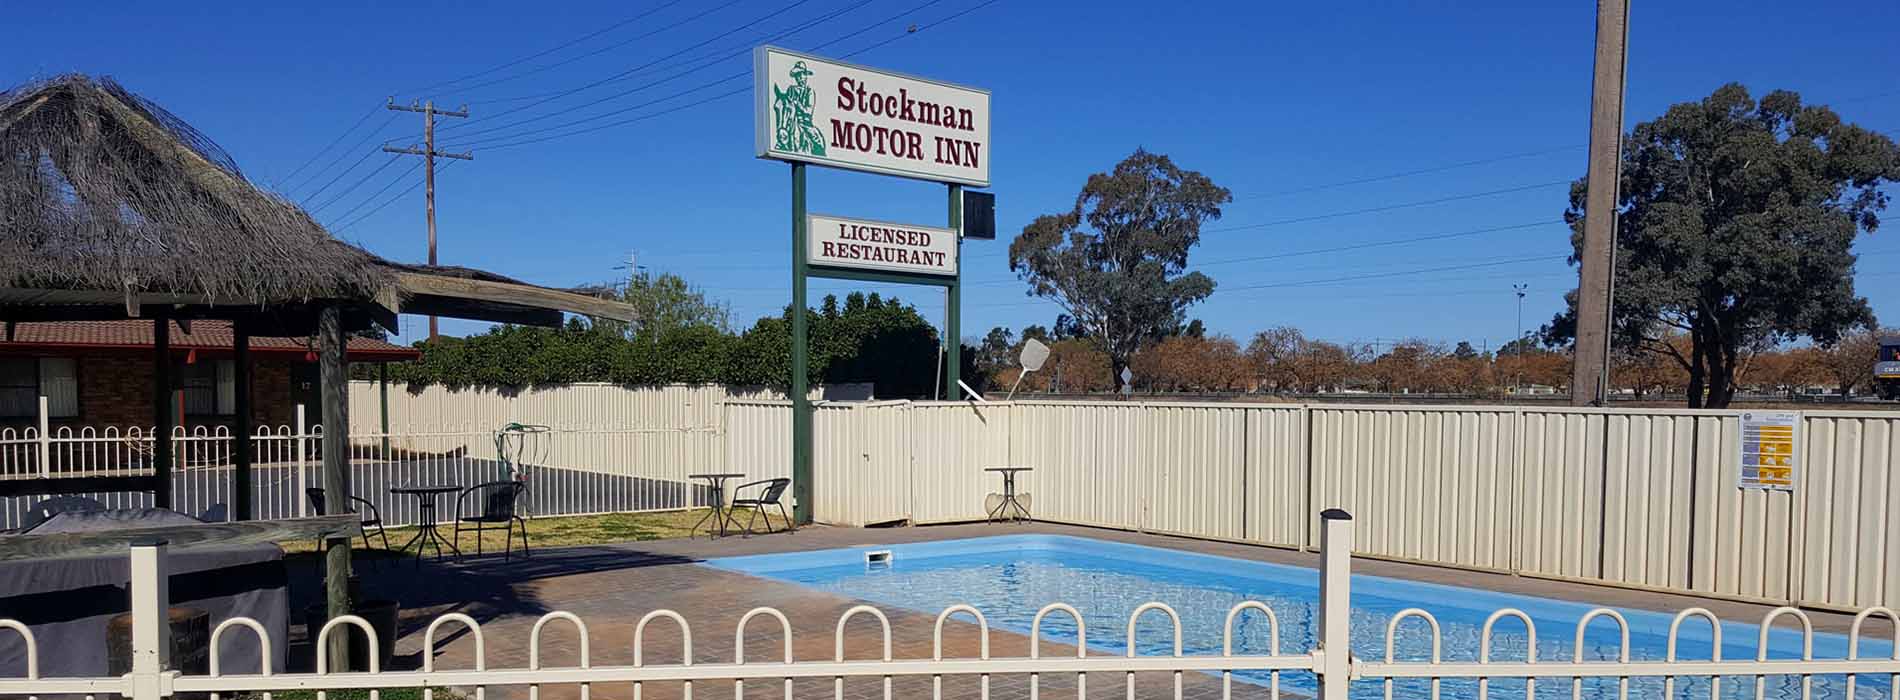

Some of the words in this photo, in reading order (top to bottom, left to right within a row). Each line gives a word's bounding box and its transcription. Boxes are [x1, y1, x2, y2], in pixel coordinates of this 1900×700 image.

[837, 76, 975, 132] Stockman
[830, 118, 925, 161] MOTOR
[934, 136, 981, 169] INN
[822, 241, 946, 267] RESTAURANT
[839, 223, 931, 247] LICENSED
